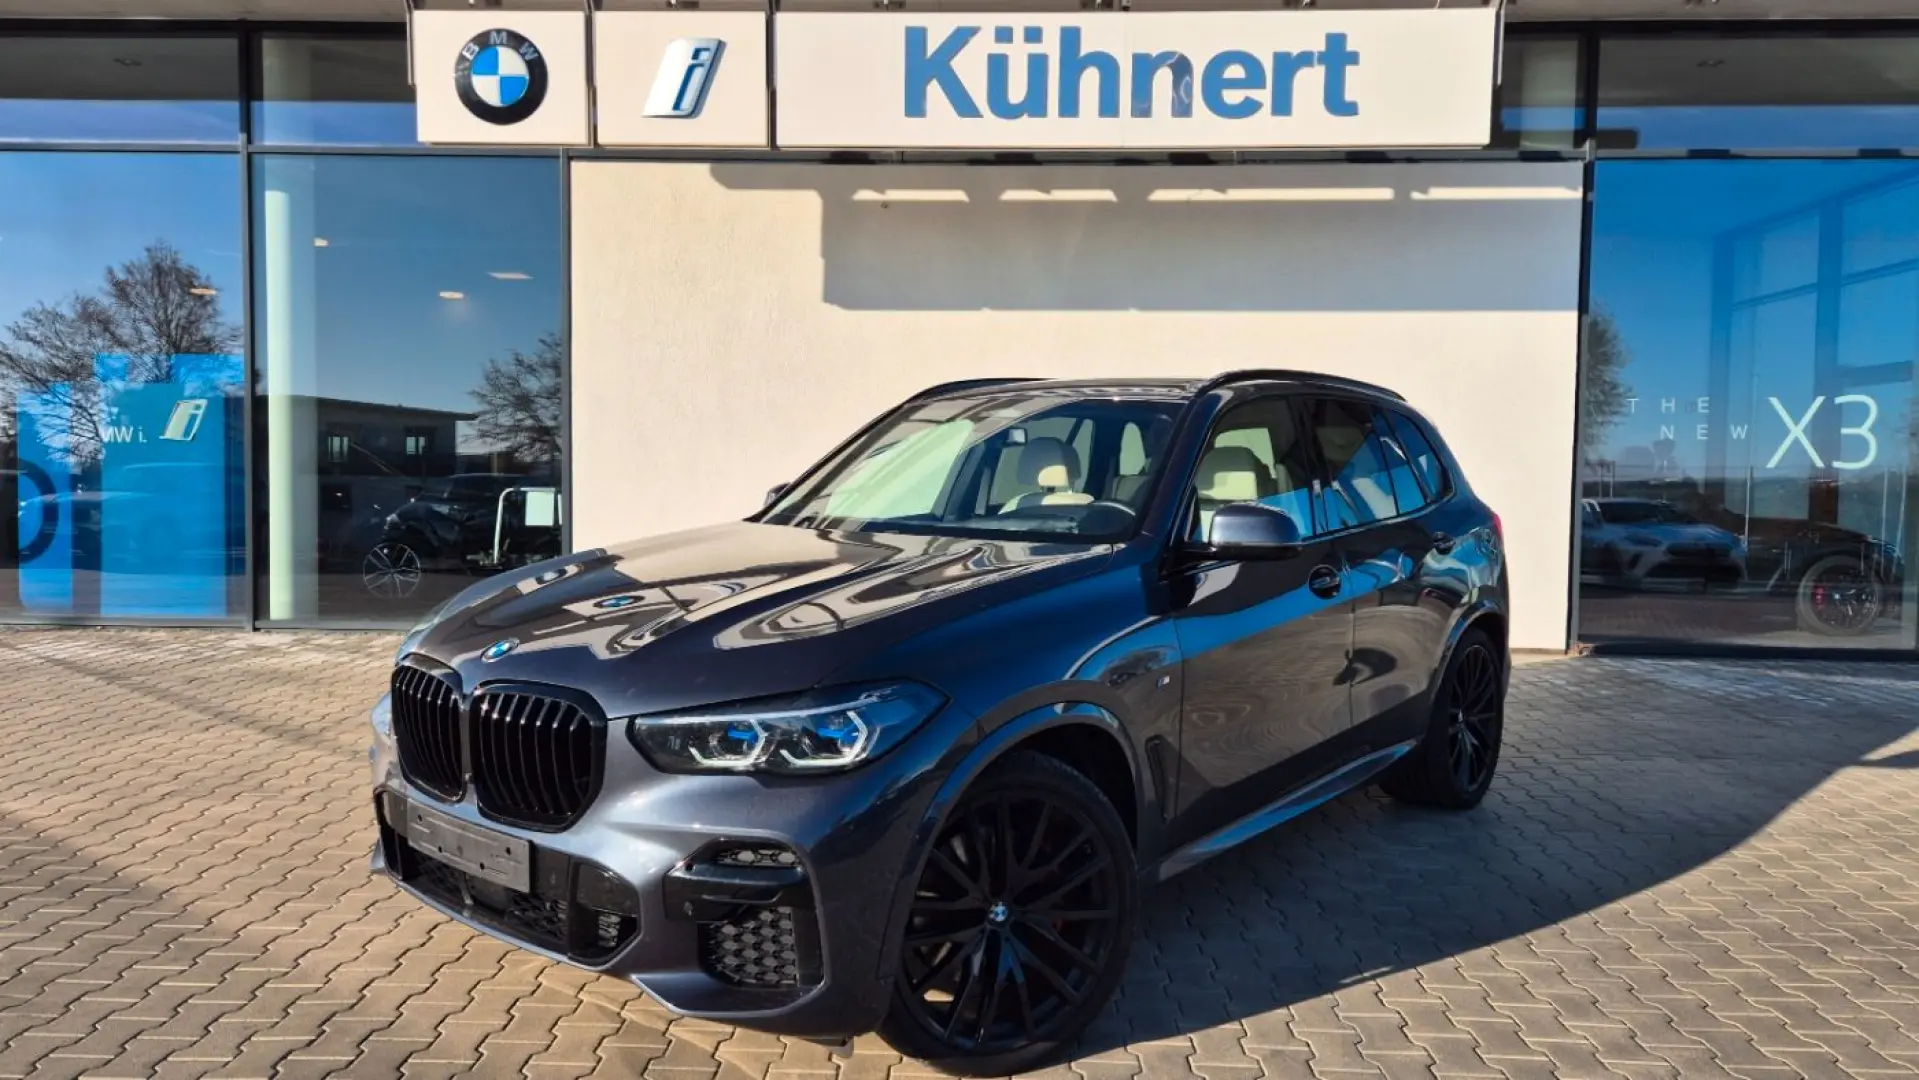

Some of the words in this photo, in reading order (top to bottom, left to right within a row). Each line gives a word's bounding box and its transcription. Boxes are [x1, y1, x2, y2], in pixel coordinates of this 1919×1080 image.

[461, 31, 539, 61] BMW
[904, 26, 1360, 119] Kühnert
[1628, 397, 1711, 413] THE
[1660, 424, 1748, 440] NEW
[1766, 394, 1878, 470] X3
